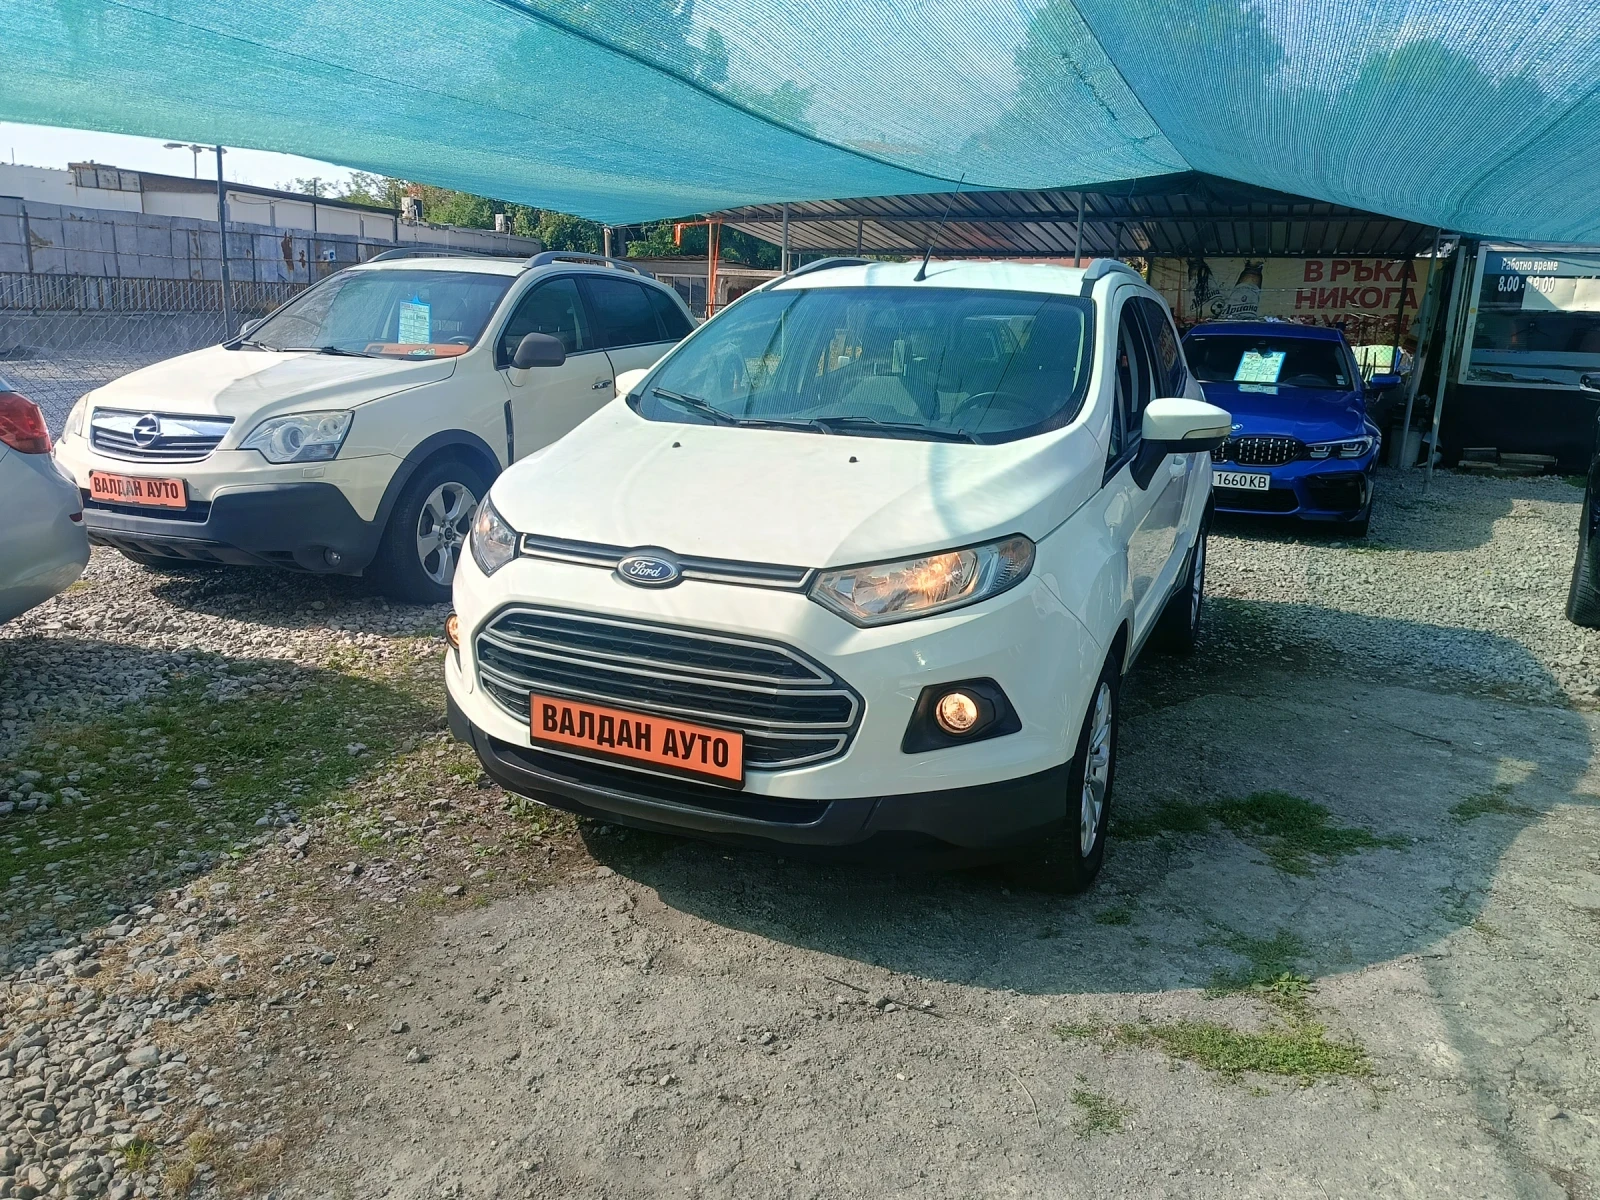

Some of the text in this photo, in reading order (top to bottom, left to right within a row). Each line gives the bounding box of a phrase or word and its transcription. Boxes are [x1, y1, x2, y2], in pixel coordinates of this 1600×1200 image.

[1303, 259, 1418, 283] В РЪКА
[1501, 257, 1558, 274] Работно време
[1498, 275, 1520, 292] 8.00
[1294, 286, 1419, 310] НИКОГА
[93, 476, 179, 499] ВАЛДАН АУТО
[1217, 473, 1248, 487] 1660
[630, 560, 662, 577] Ford
[542, 703, 729, 768] ВАЛДАН АУТО
